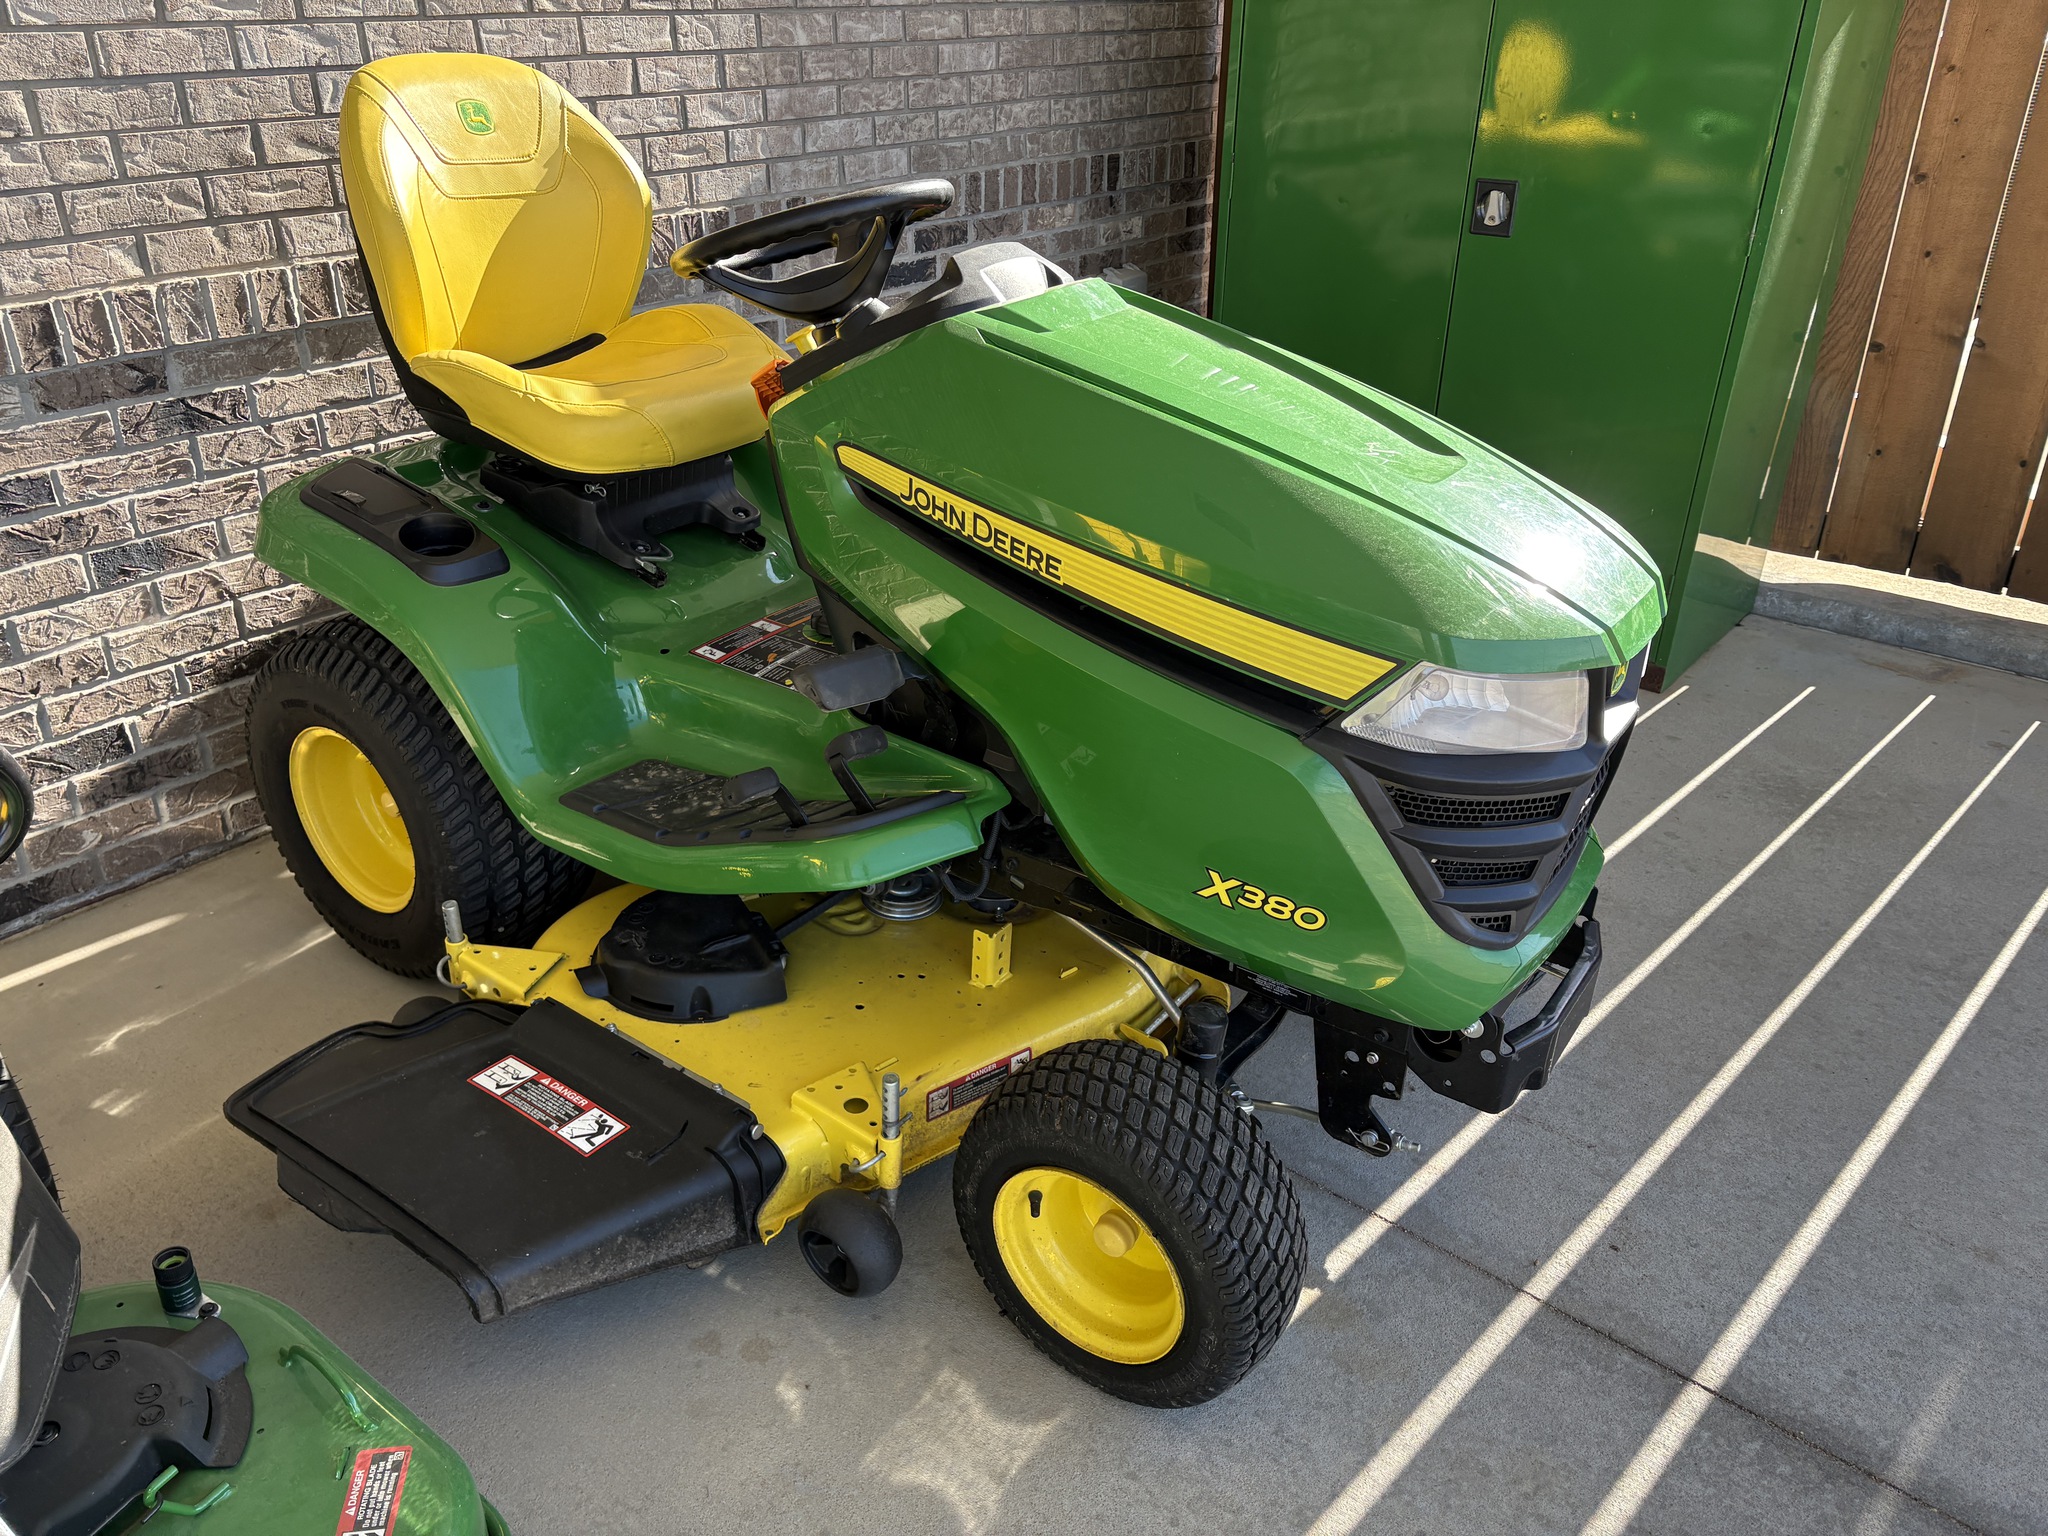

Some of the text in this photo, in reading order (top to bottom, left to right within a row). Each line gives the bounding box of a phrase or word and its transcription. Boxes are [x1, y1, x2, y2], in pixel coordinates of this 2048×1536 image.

[900, 477, 1063, 582] JOHN DEERE
[1191, 866, 1328, 931] X380
[971, 1063, 997, 1079] DANGER
[550, 1082, 588, 1106] DANGER
[348, 1470, 364, 1505] DANGER
[357, 1464, 377, 1520] ROTATING BLADE
